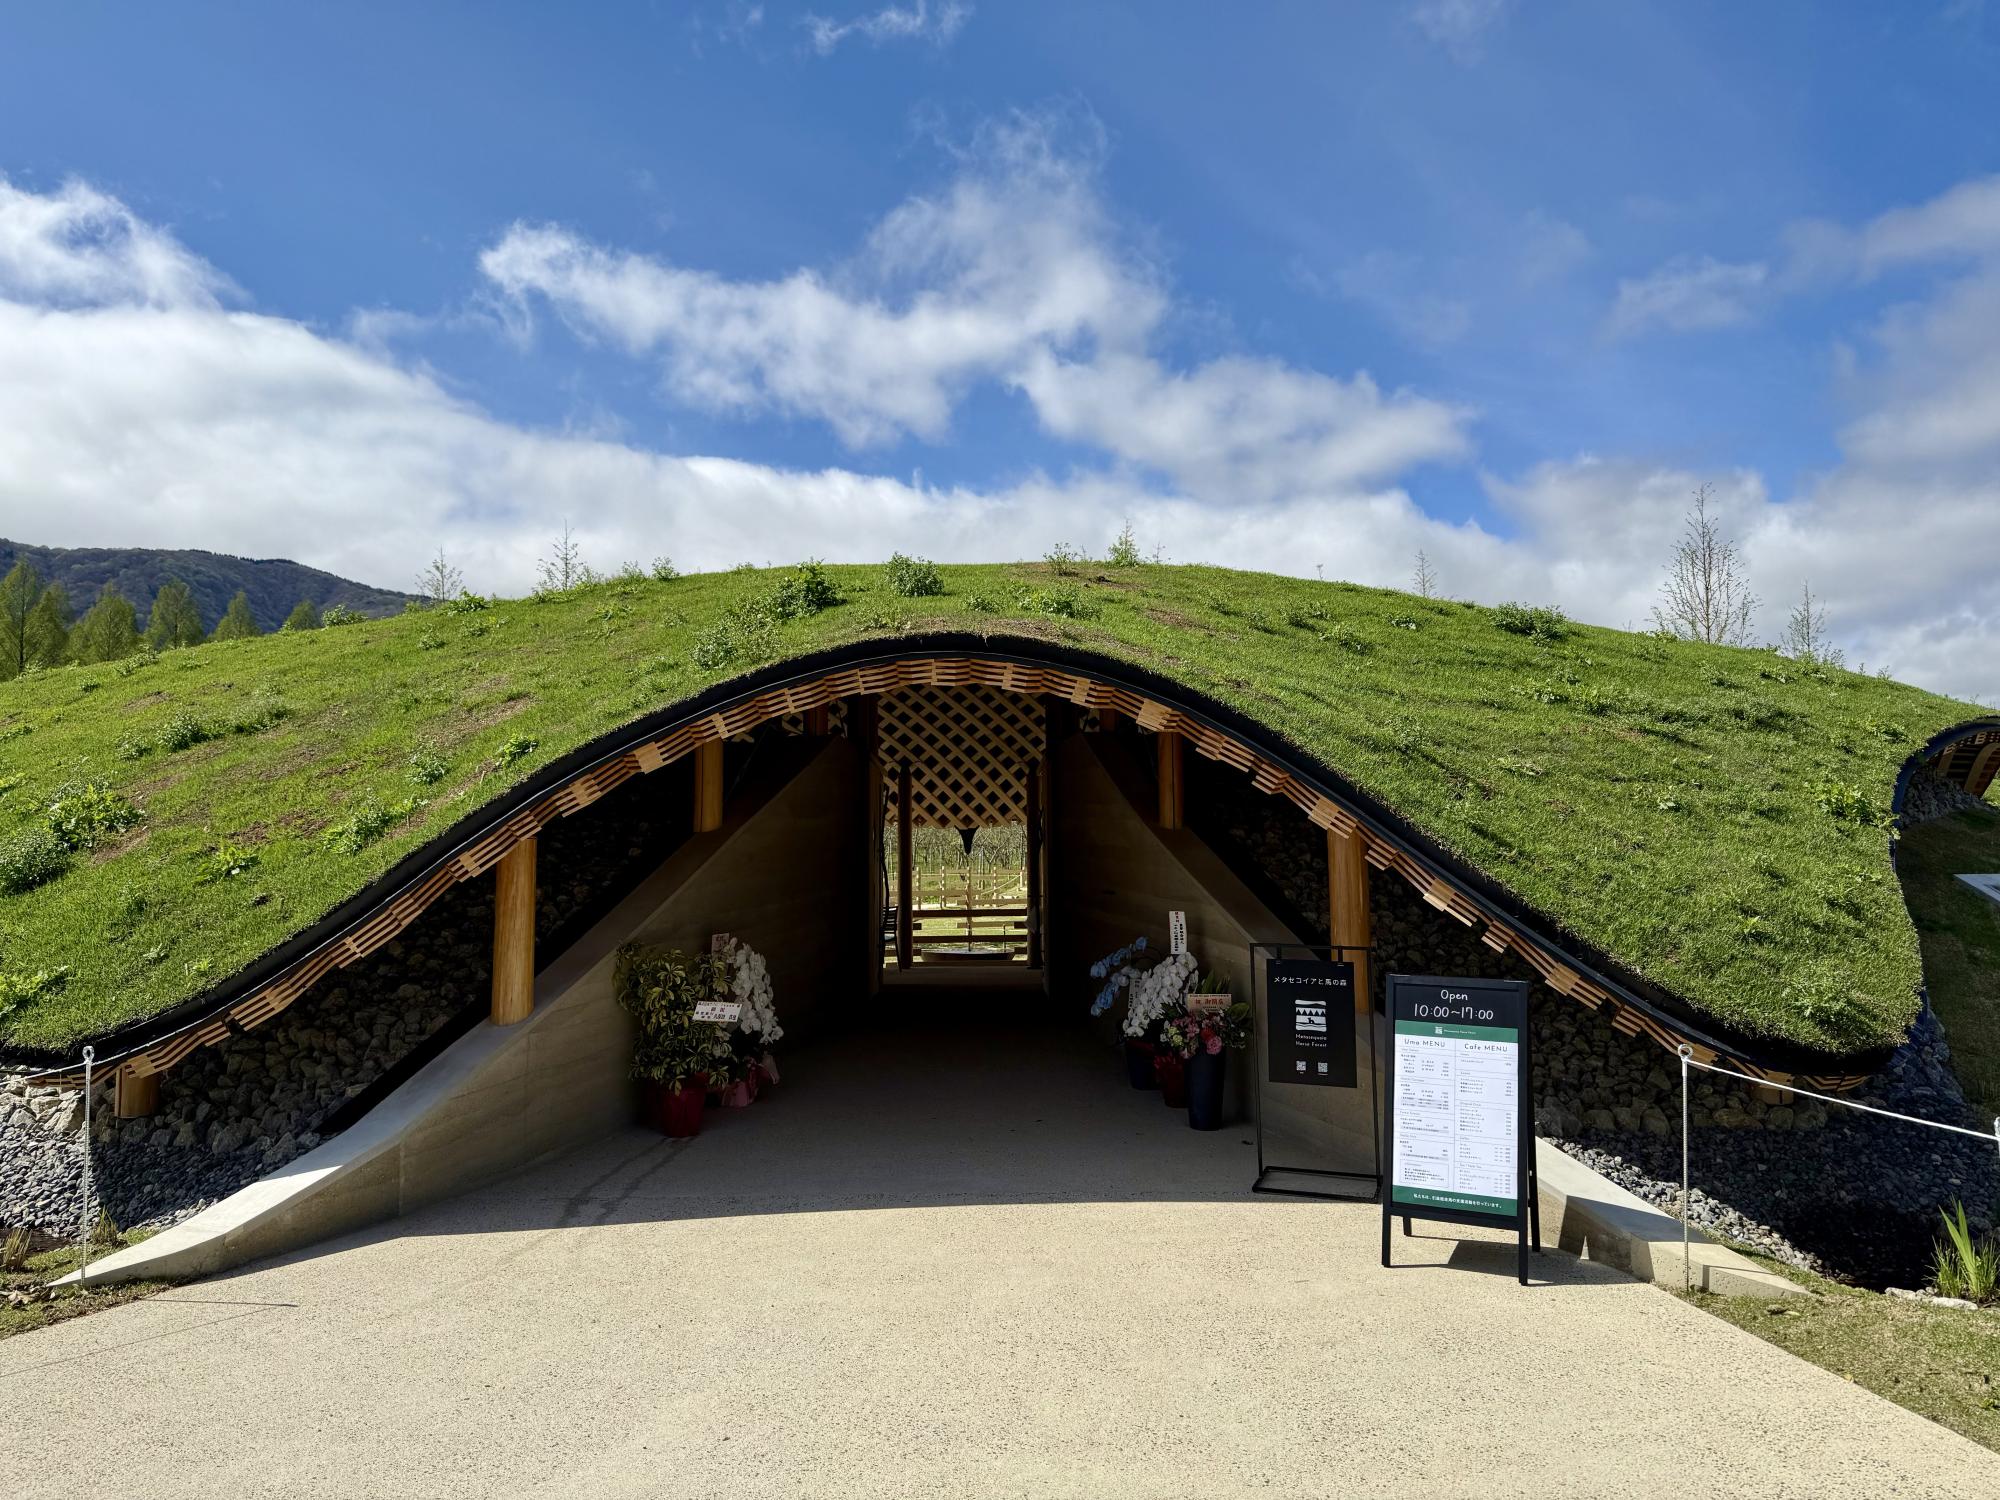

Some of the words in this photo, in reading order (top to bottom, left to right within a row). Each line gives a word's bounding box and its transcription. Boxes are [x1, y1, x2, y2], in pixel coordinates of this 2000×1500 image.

[1273, 976, 1347, 986] メタセコイアと馬の森
[1440, 989, 1468, 1003] Open
[1422, 1040, 1446, 1048] MENU
